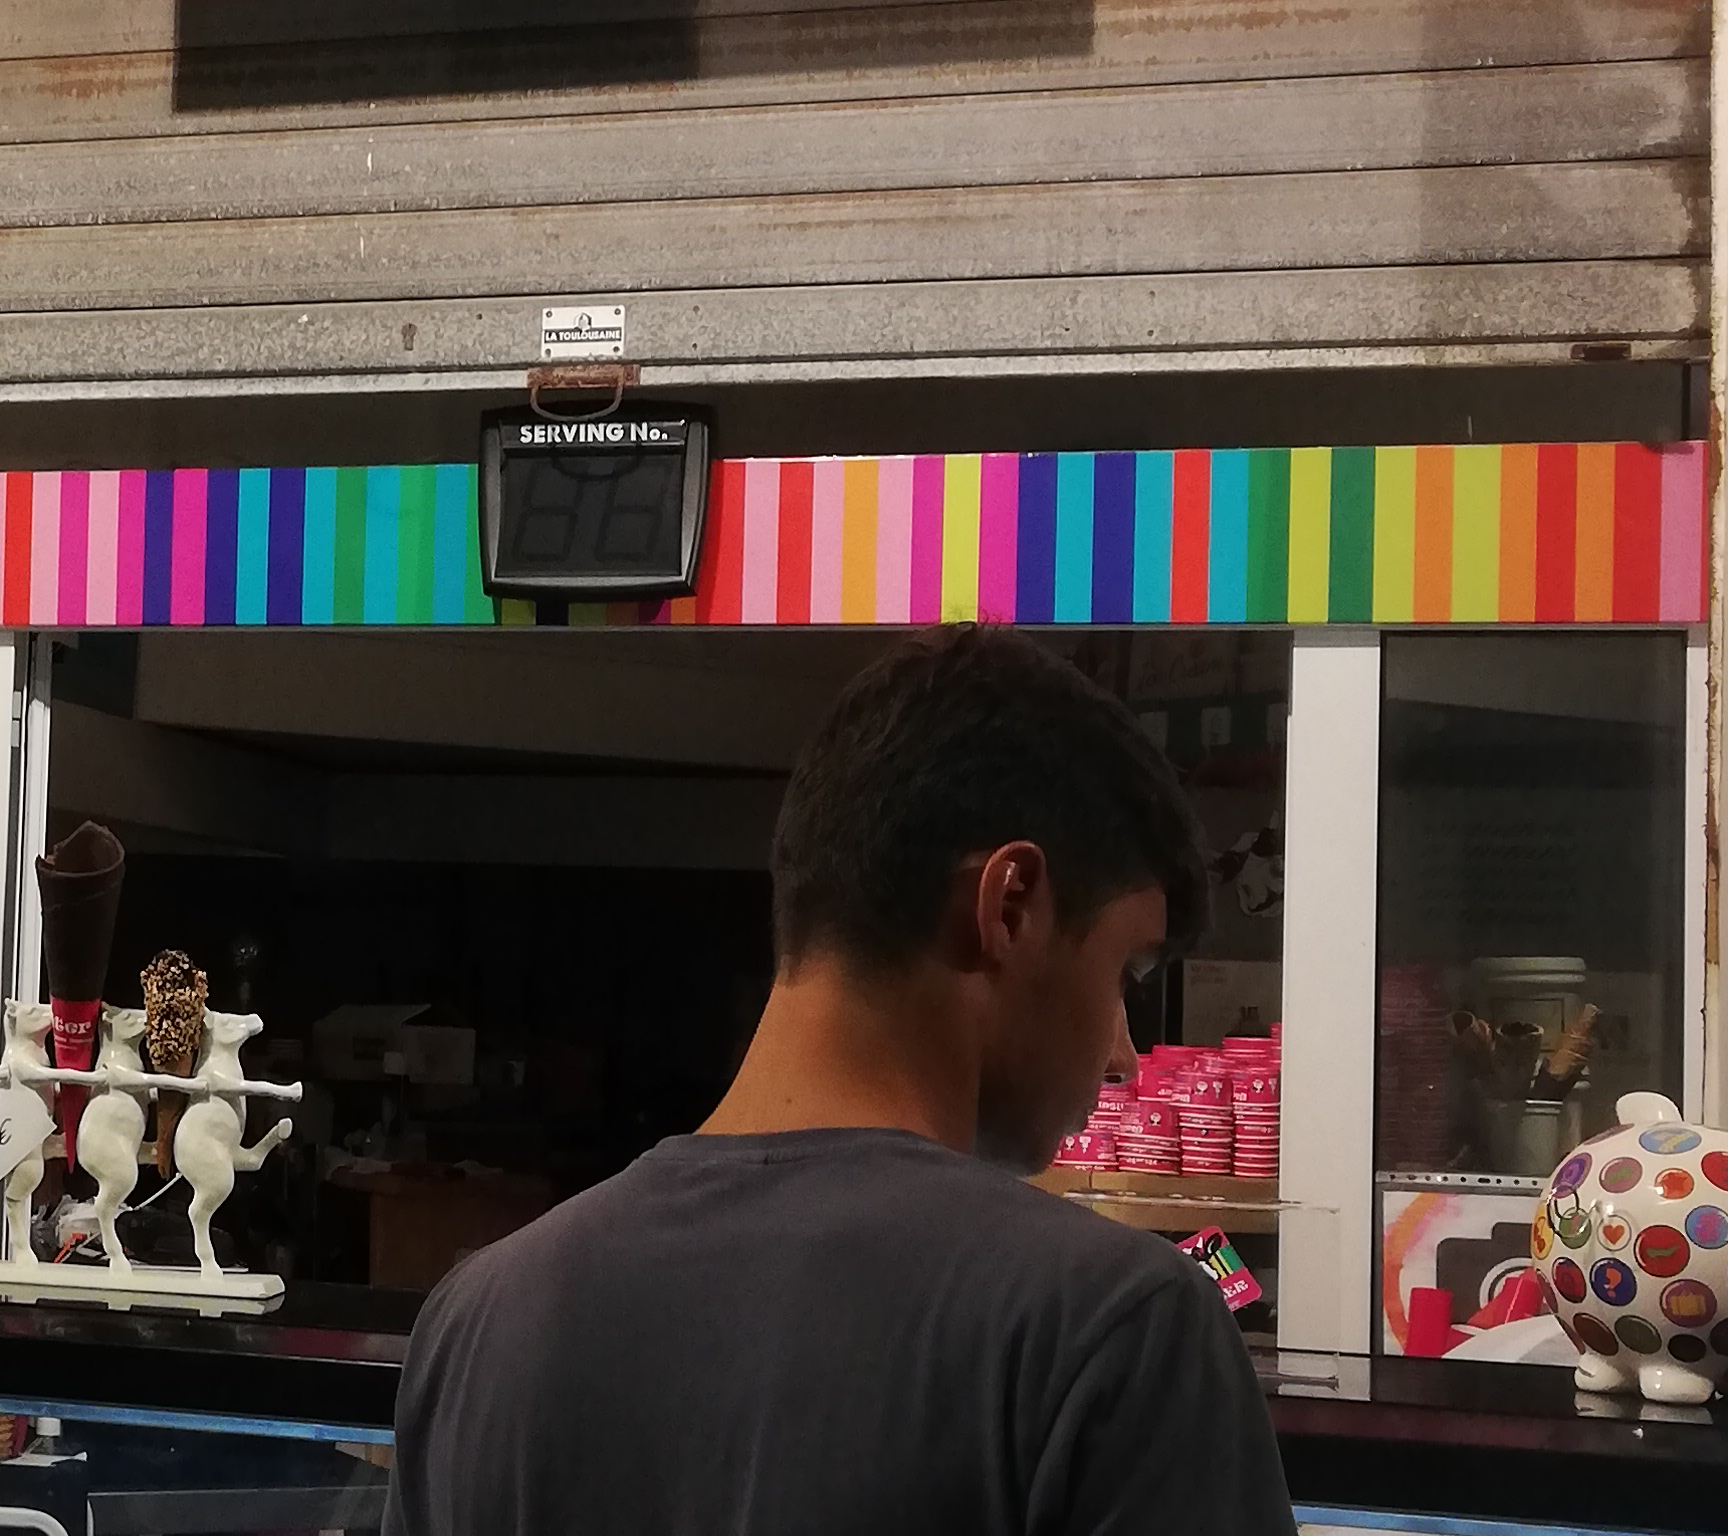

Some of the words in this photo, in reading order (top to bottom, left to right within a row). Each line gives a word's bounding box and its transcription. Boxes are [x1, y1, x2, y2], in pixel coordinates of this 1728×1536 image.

[545, 331, 558, 341] LA
[558, 330, 621, 341] TOULOUSAINE
[520, 423, 624, 444] SERVING
